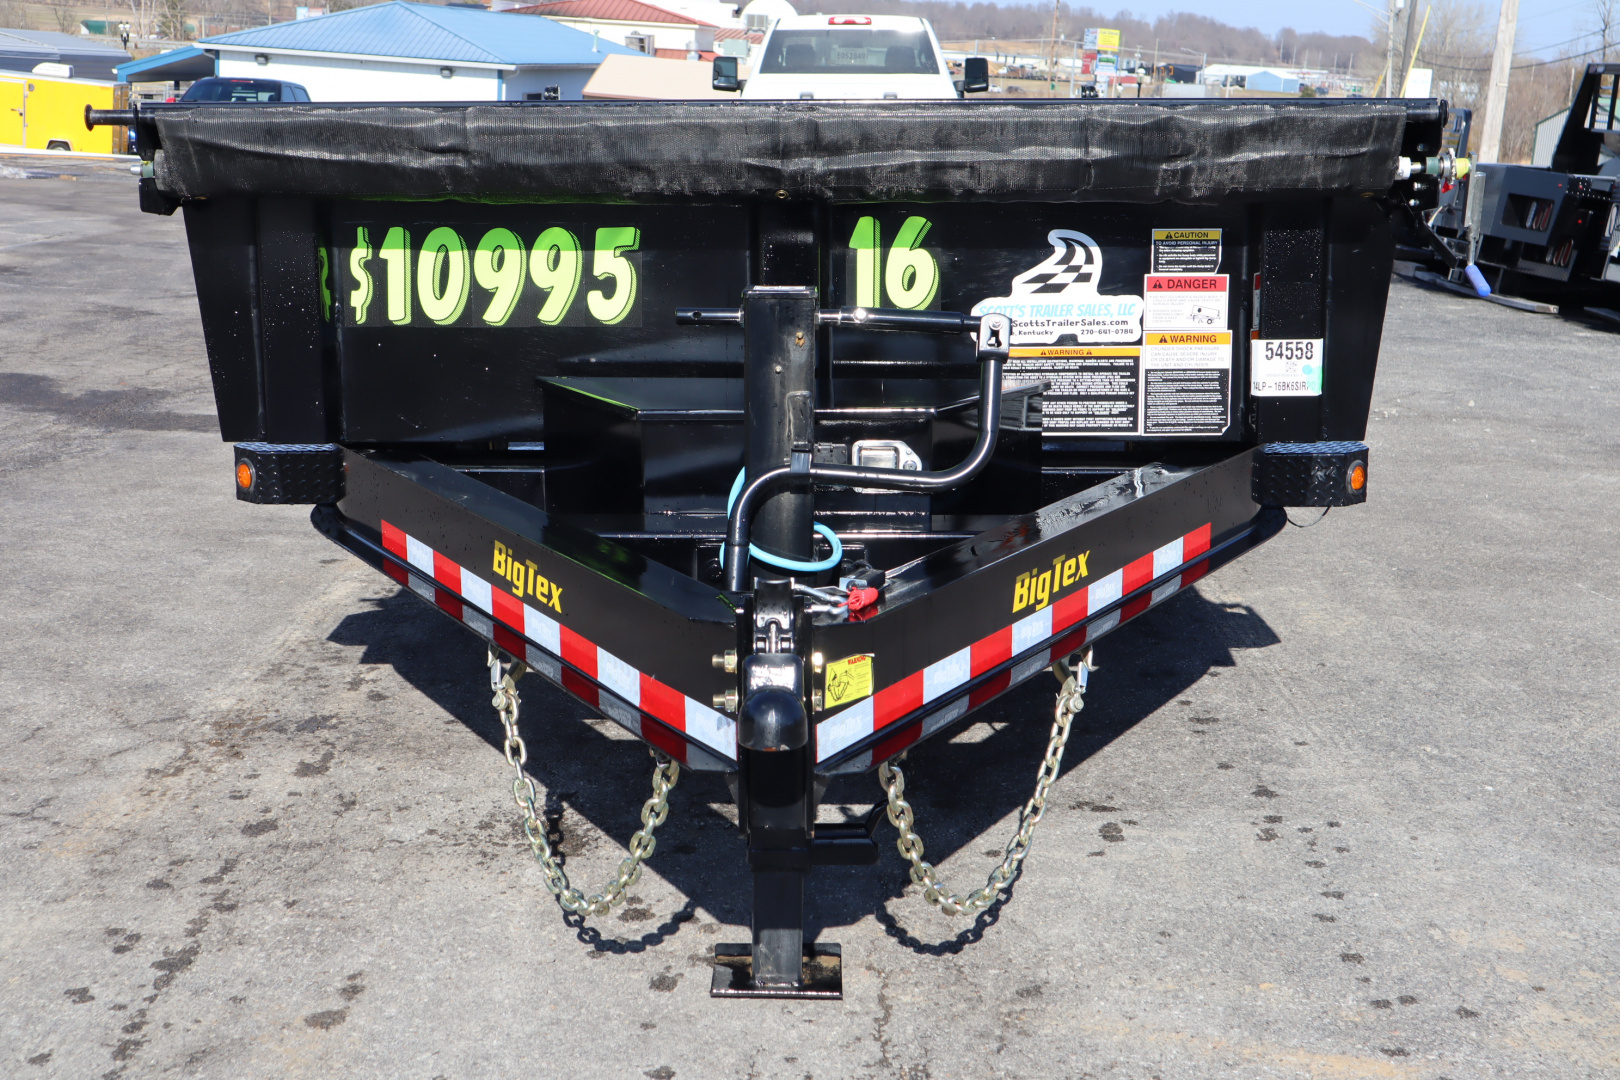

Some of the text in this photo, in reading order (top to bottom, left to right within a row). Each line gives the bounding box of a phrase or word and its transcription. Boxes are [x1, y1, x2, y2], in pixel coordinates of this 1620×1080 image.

[848, 216, 939, 310] 16
[350, 226, 640, 324] $10995
[1167, 278, 1217, 289] DANGER
[1029, 304, 1074, 318] TRAILER
[1076, 304, 1113, 318] SALES,
[1117, 304, 1136, 318] LLC
[1265, 342, 1314, 360] 54558
